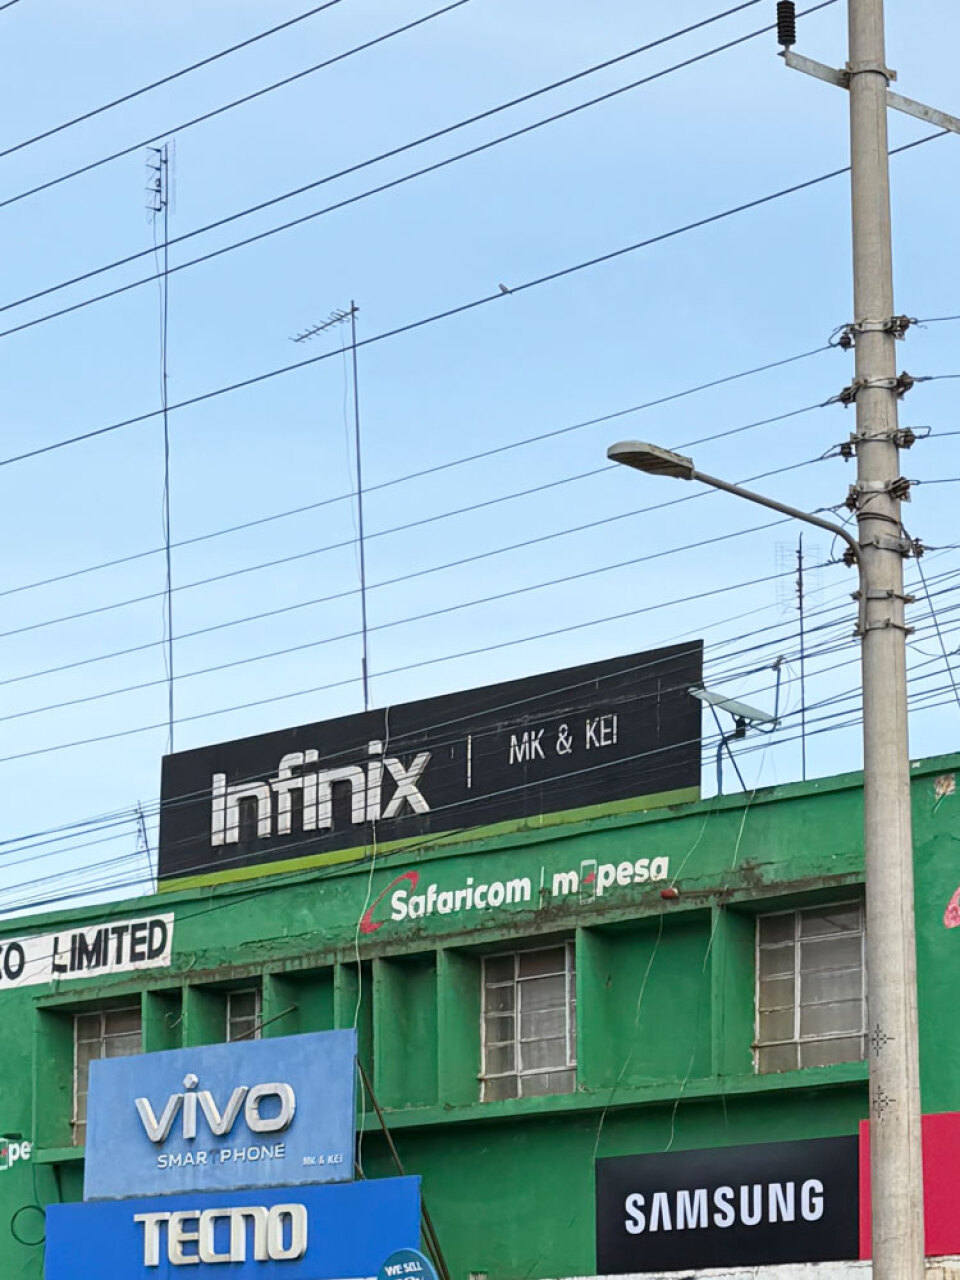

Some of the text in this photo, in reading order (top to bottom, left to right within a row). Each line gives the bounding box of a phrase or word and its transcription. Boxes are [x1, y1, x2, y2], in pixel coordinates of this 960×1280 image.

[509, 714, 618, 765] MK & KEI
[211, 740, 431, 846] Infinix
[391, 877, 531, 920] Safaricom
[52, 919, 168, 973] LIMITED
[135, 1073, 296, 1142] vivo
[625, 1179, 824, 1235] SAMSUNG
[134, 1203, 308, 1267] TECNO
[385, 1264, 403, 1276] WE
